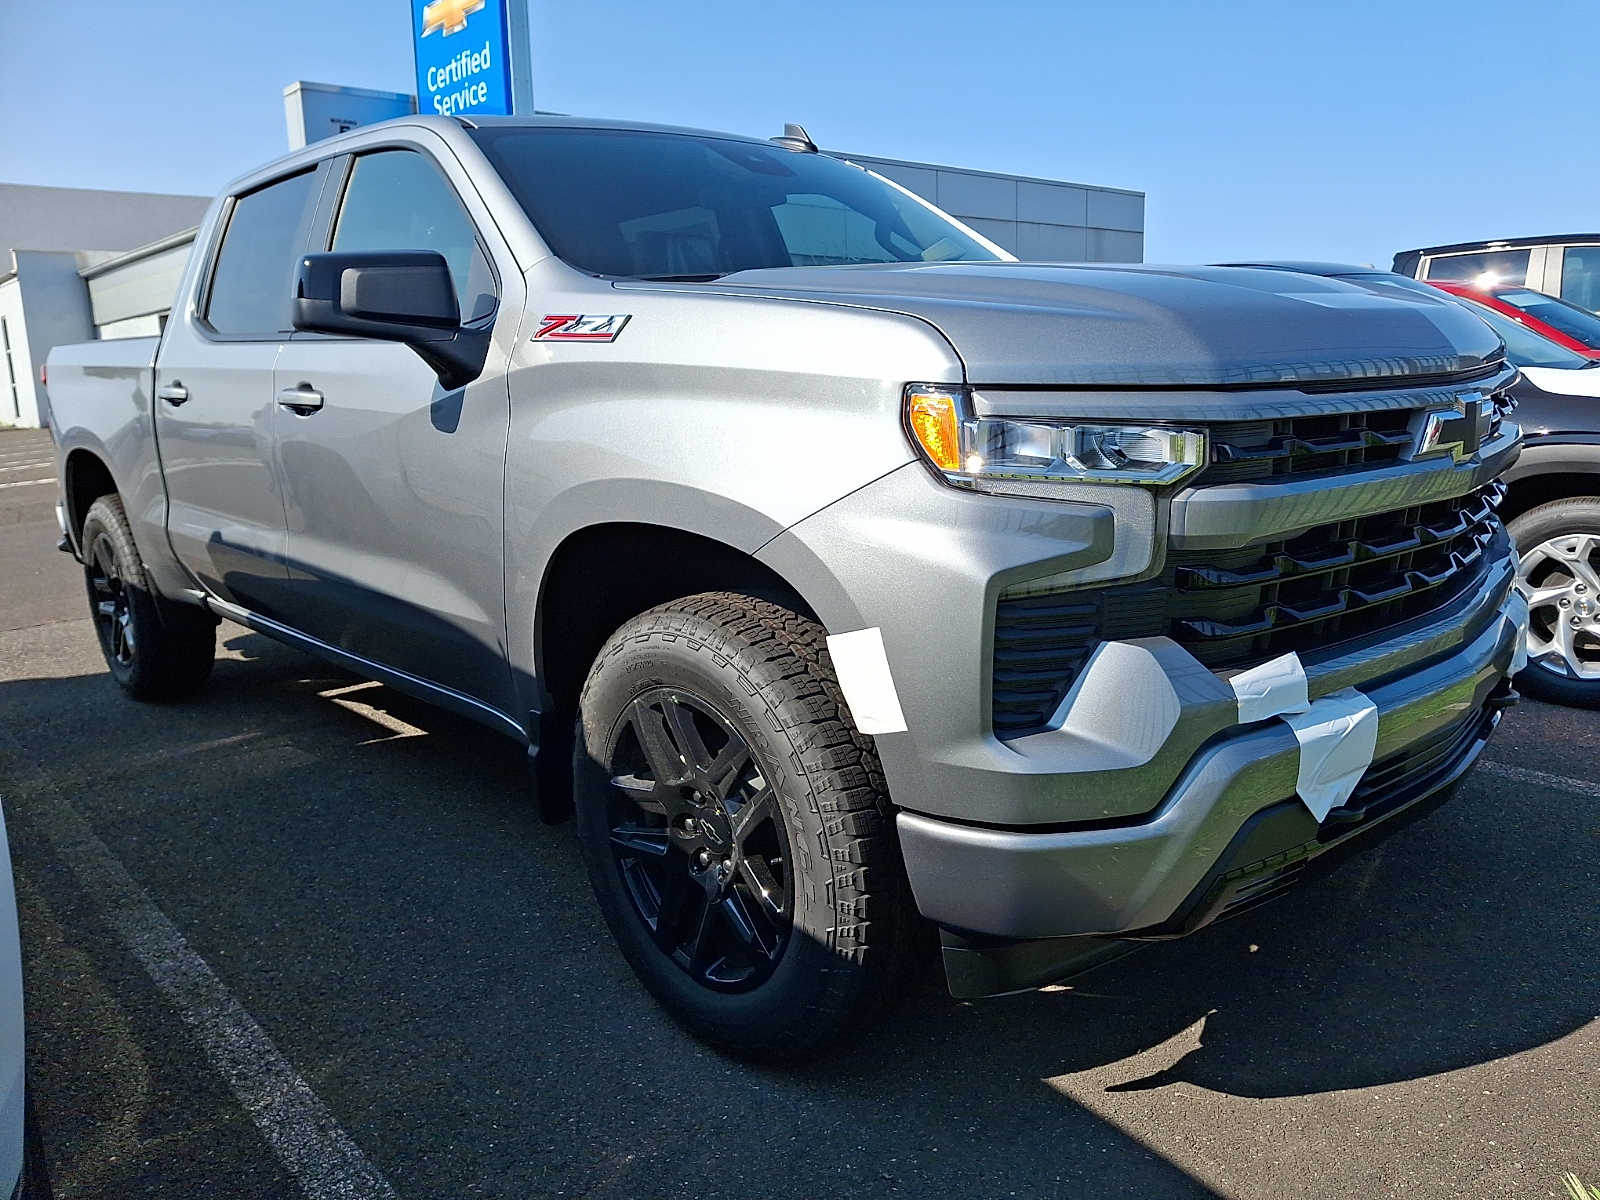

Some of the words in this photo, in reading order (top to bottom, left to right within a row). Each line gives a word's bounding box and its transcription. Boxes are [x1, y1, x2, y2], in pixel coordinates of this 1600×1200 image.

[427, 41, 491, 92] Certified
[433, 81, 488, 116] Service
[533, 315, 629, 341] Z71
